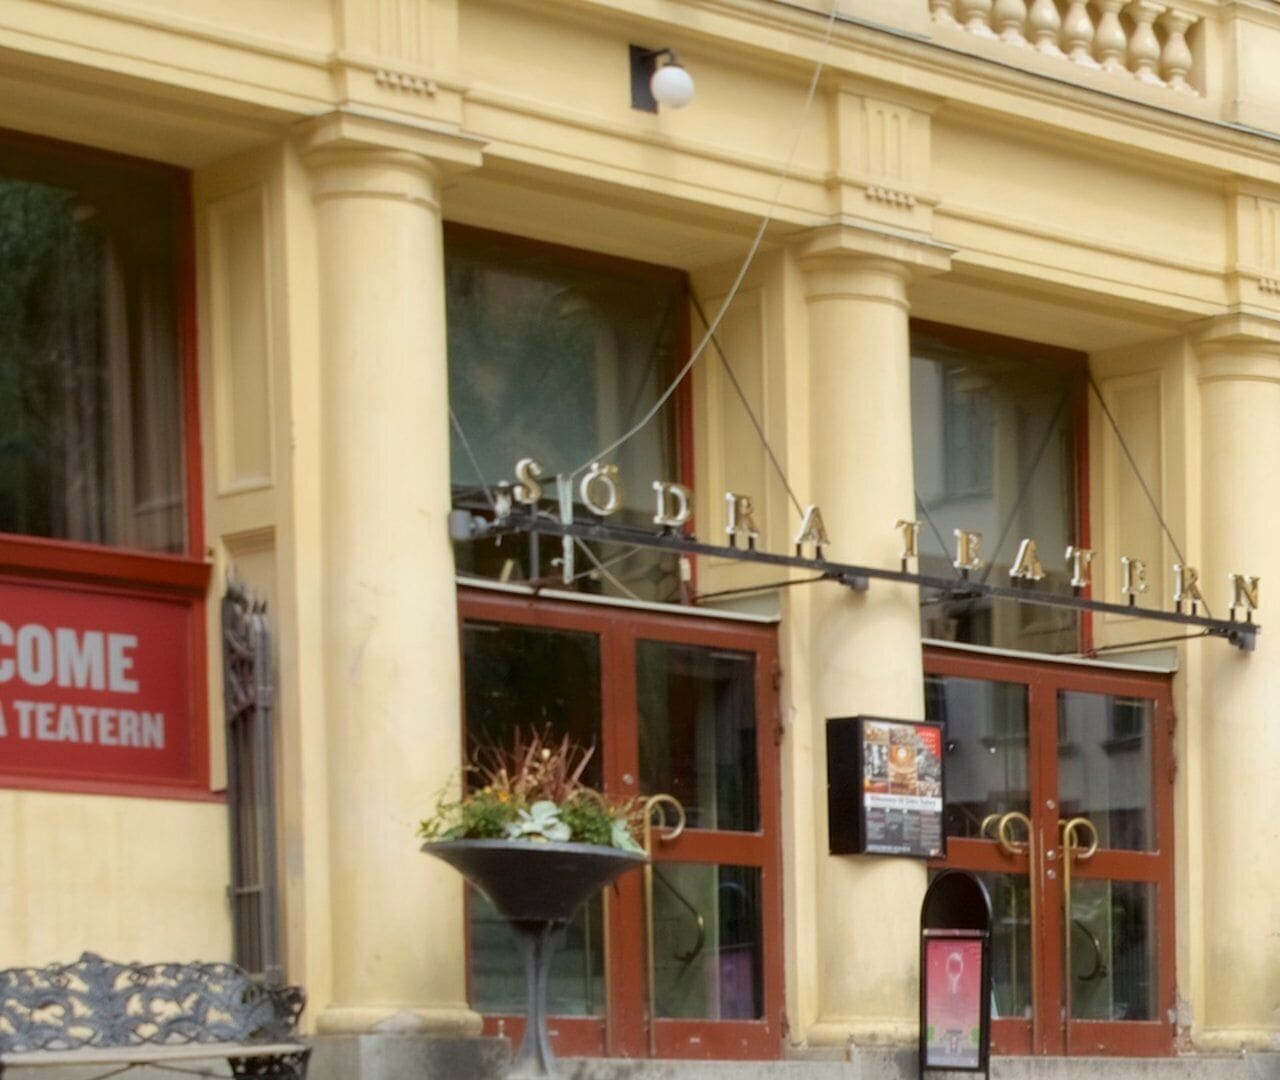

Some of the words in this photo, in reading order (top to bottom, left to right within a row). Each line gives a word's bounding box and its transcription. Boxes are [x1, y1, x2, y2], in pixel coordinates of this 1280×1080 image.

[513, 457, 830, 545] SÖDRA
[896, 518, 1261, 609] TEATERN
[13, 700, 165, 749] TEATERN
